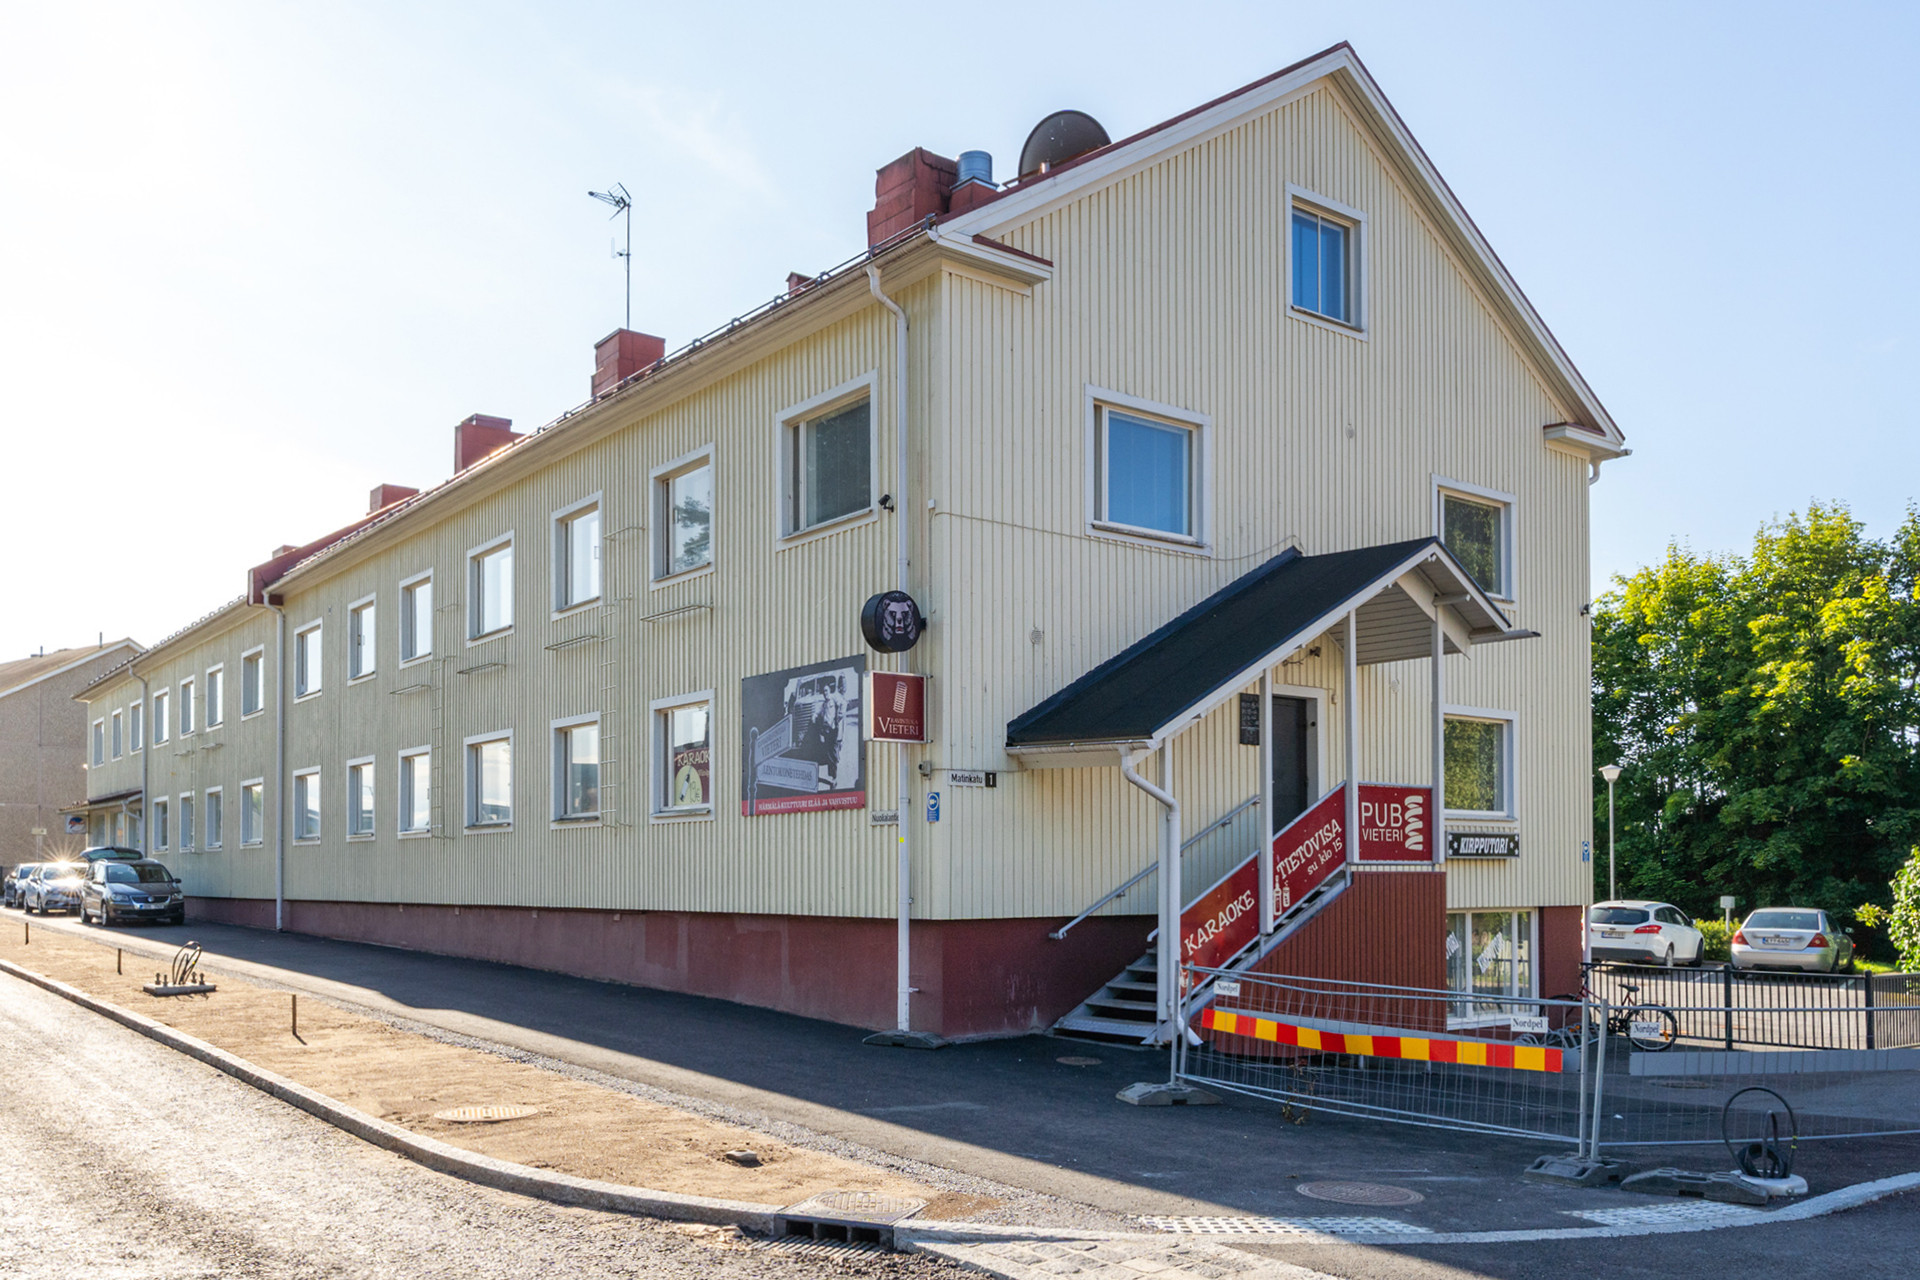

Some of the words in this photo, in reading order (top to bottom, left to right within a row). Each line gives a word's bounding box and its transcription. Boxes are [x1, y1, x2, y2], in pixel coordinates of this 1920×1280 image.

[951, 773, 983, 784] Matinkatu
[828, 796, 858, 807] VAHVISTUU
[1361, 802, 1403, 828] PUB
[1361, 828, 1403, 842] VIETERI
[1276, 818, 1342, 880] TIETOVISA
[1459, 837, 1509, 855] KIRPPUTORI
[1306, 861, 1319, 875] su
[1318, 849, 1333, 865] klo
[1332, 837, 1343, 852] 15
[1184, 889, 1255, 957] KARAOKE
[1217, 983, 1239, 994] Nordpel
[1512, 1018, 1543, 1031] Nordpel
[1633, 1024, 1659, 1036] Nordpel
